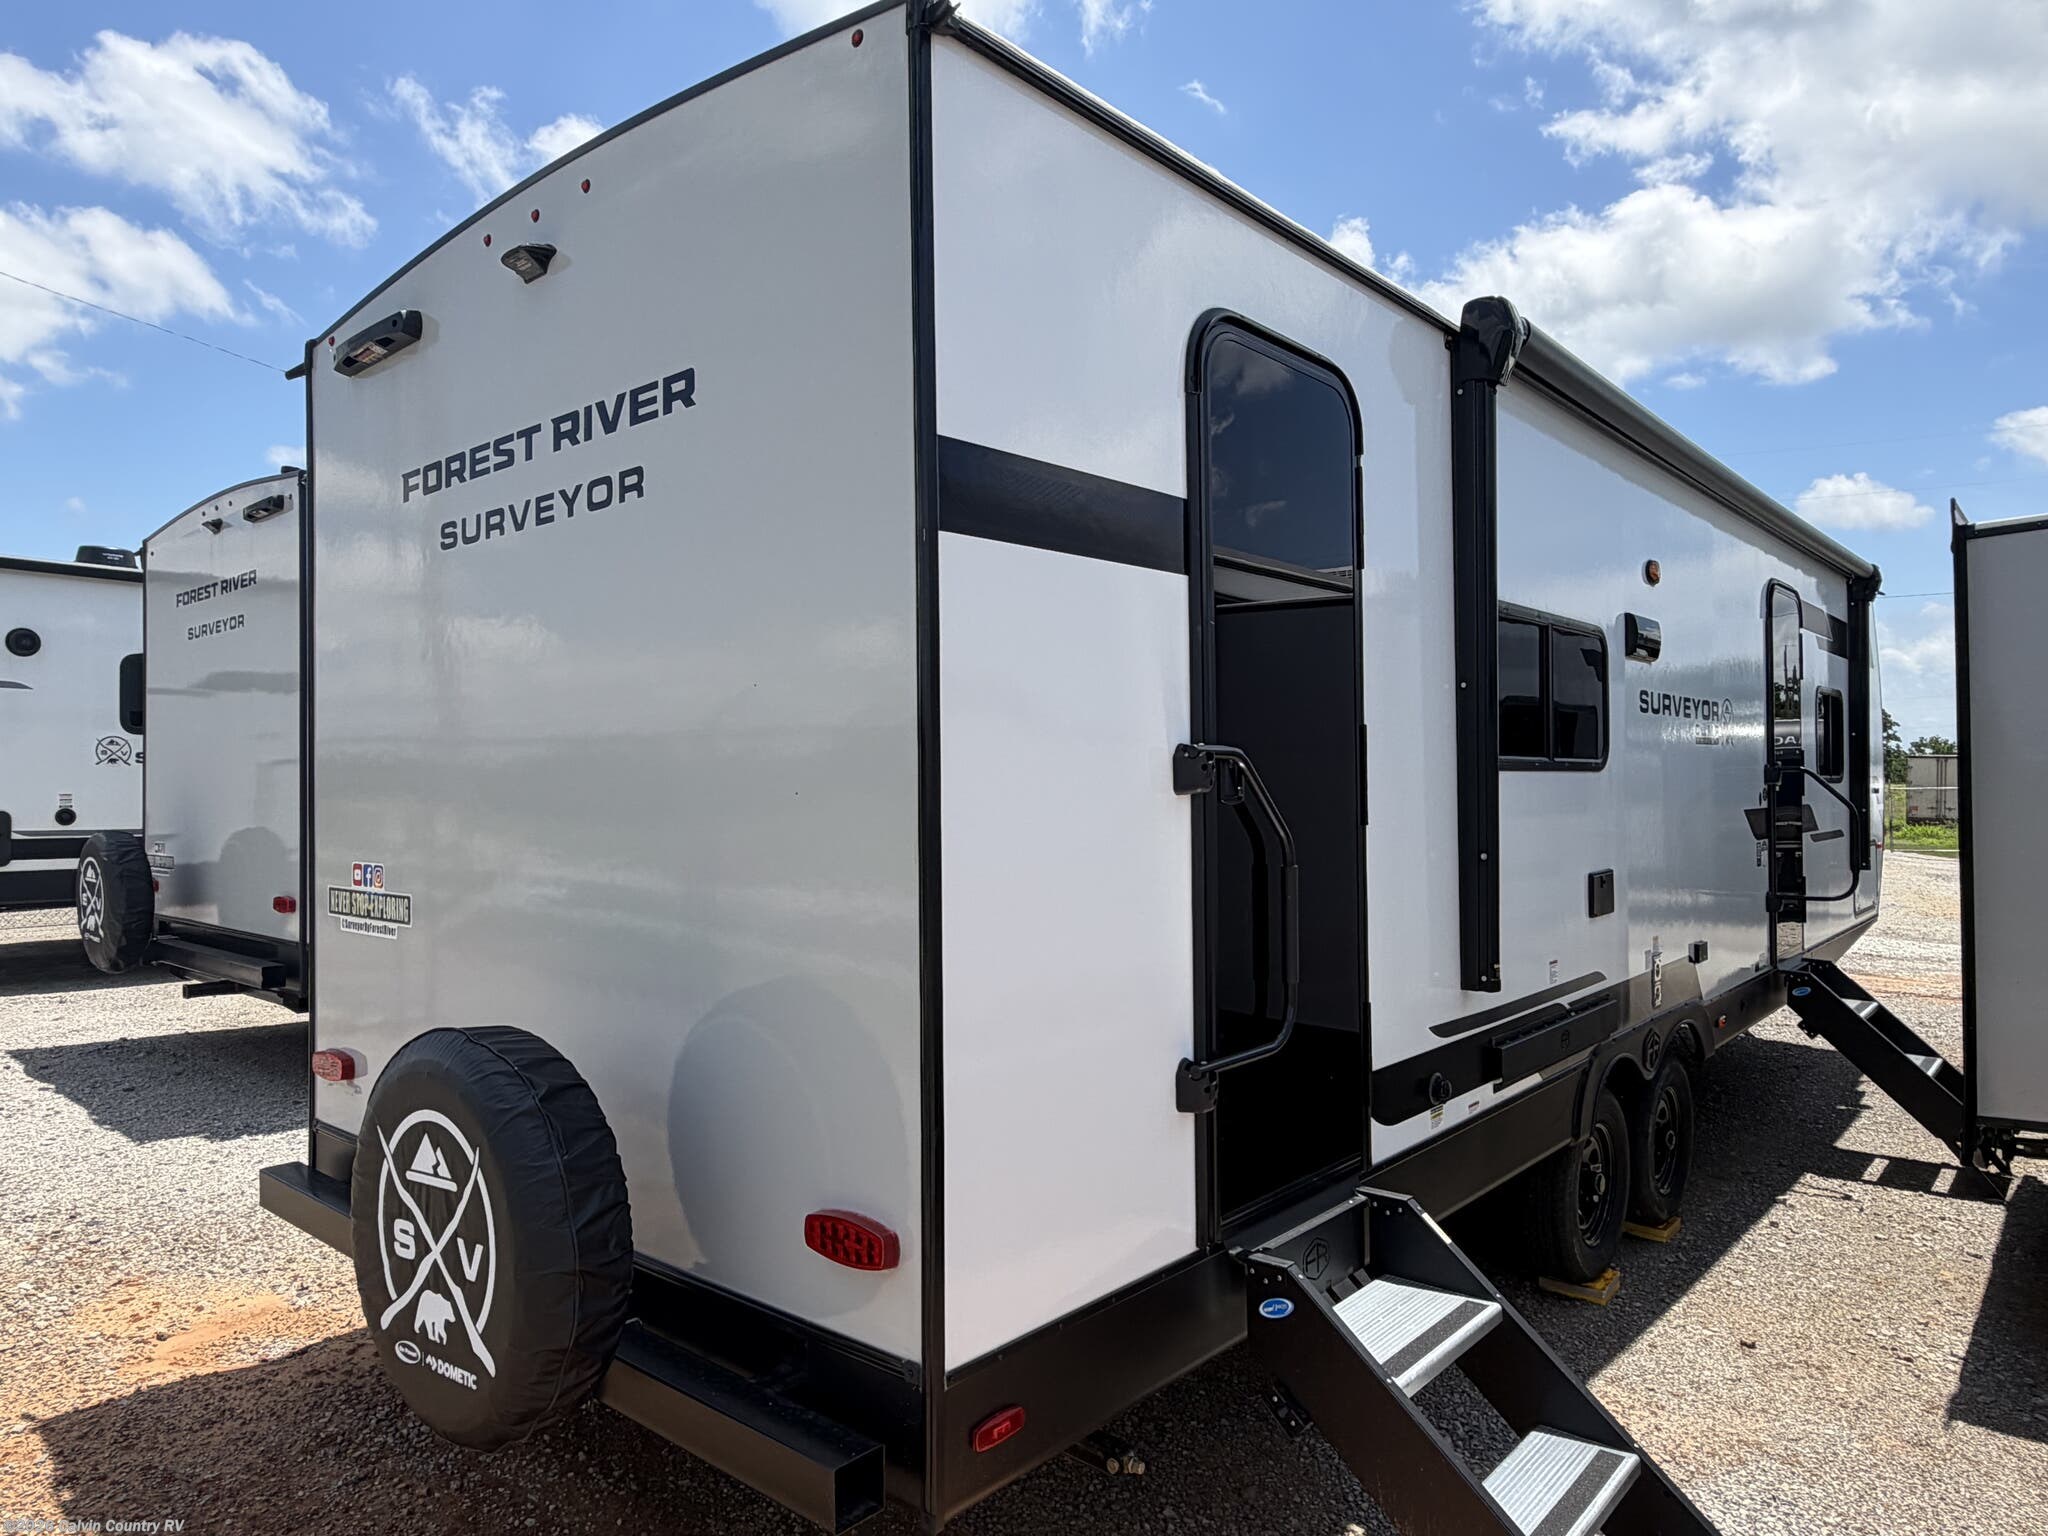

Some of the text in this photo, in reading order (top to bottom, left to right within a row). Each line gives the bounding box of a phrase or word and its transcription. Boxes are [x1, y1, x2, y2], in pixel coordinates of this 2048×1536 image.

[402, 367, 697, 503] FOREST RIVER
[440, 465, 645, 551] SURVEYOR
[176, 569, 257, 608] FOREST RIVER
[187, 614, 244, 640] SURVEYOR
[1639, 690, 1719, 721] SURVEYOR
[330, 890, 350, 913] NEVER
[370, 895, 408, 922] EXPLORING
[394, 1218, 483, 1282] S V
[437, 1358, 478, 1391] DOMETIC
